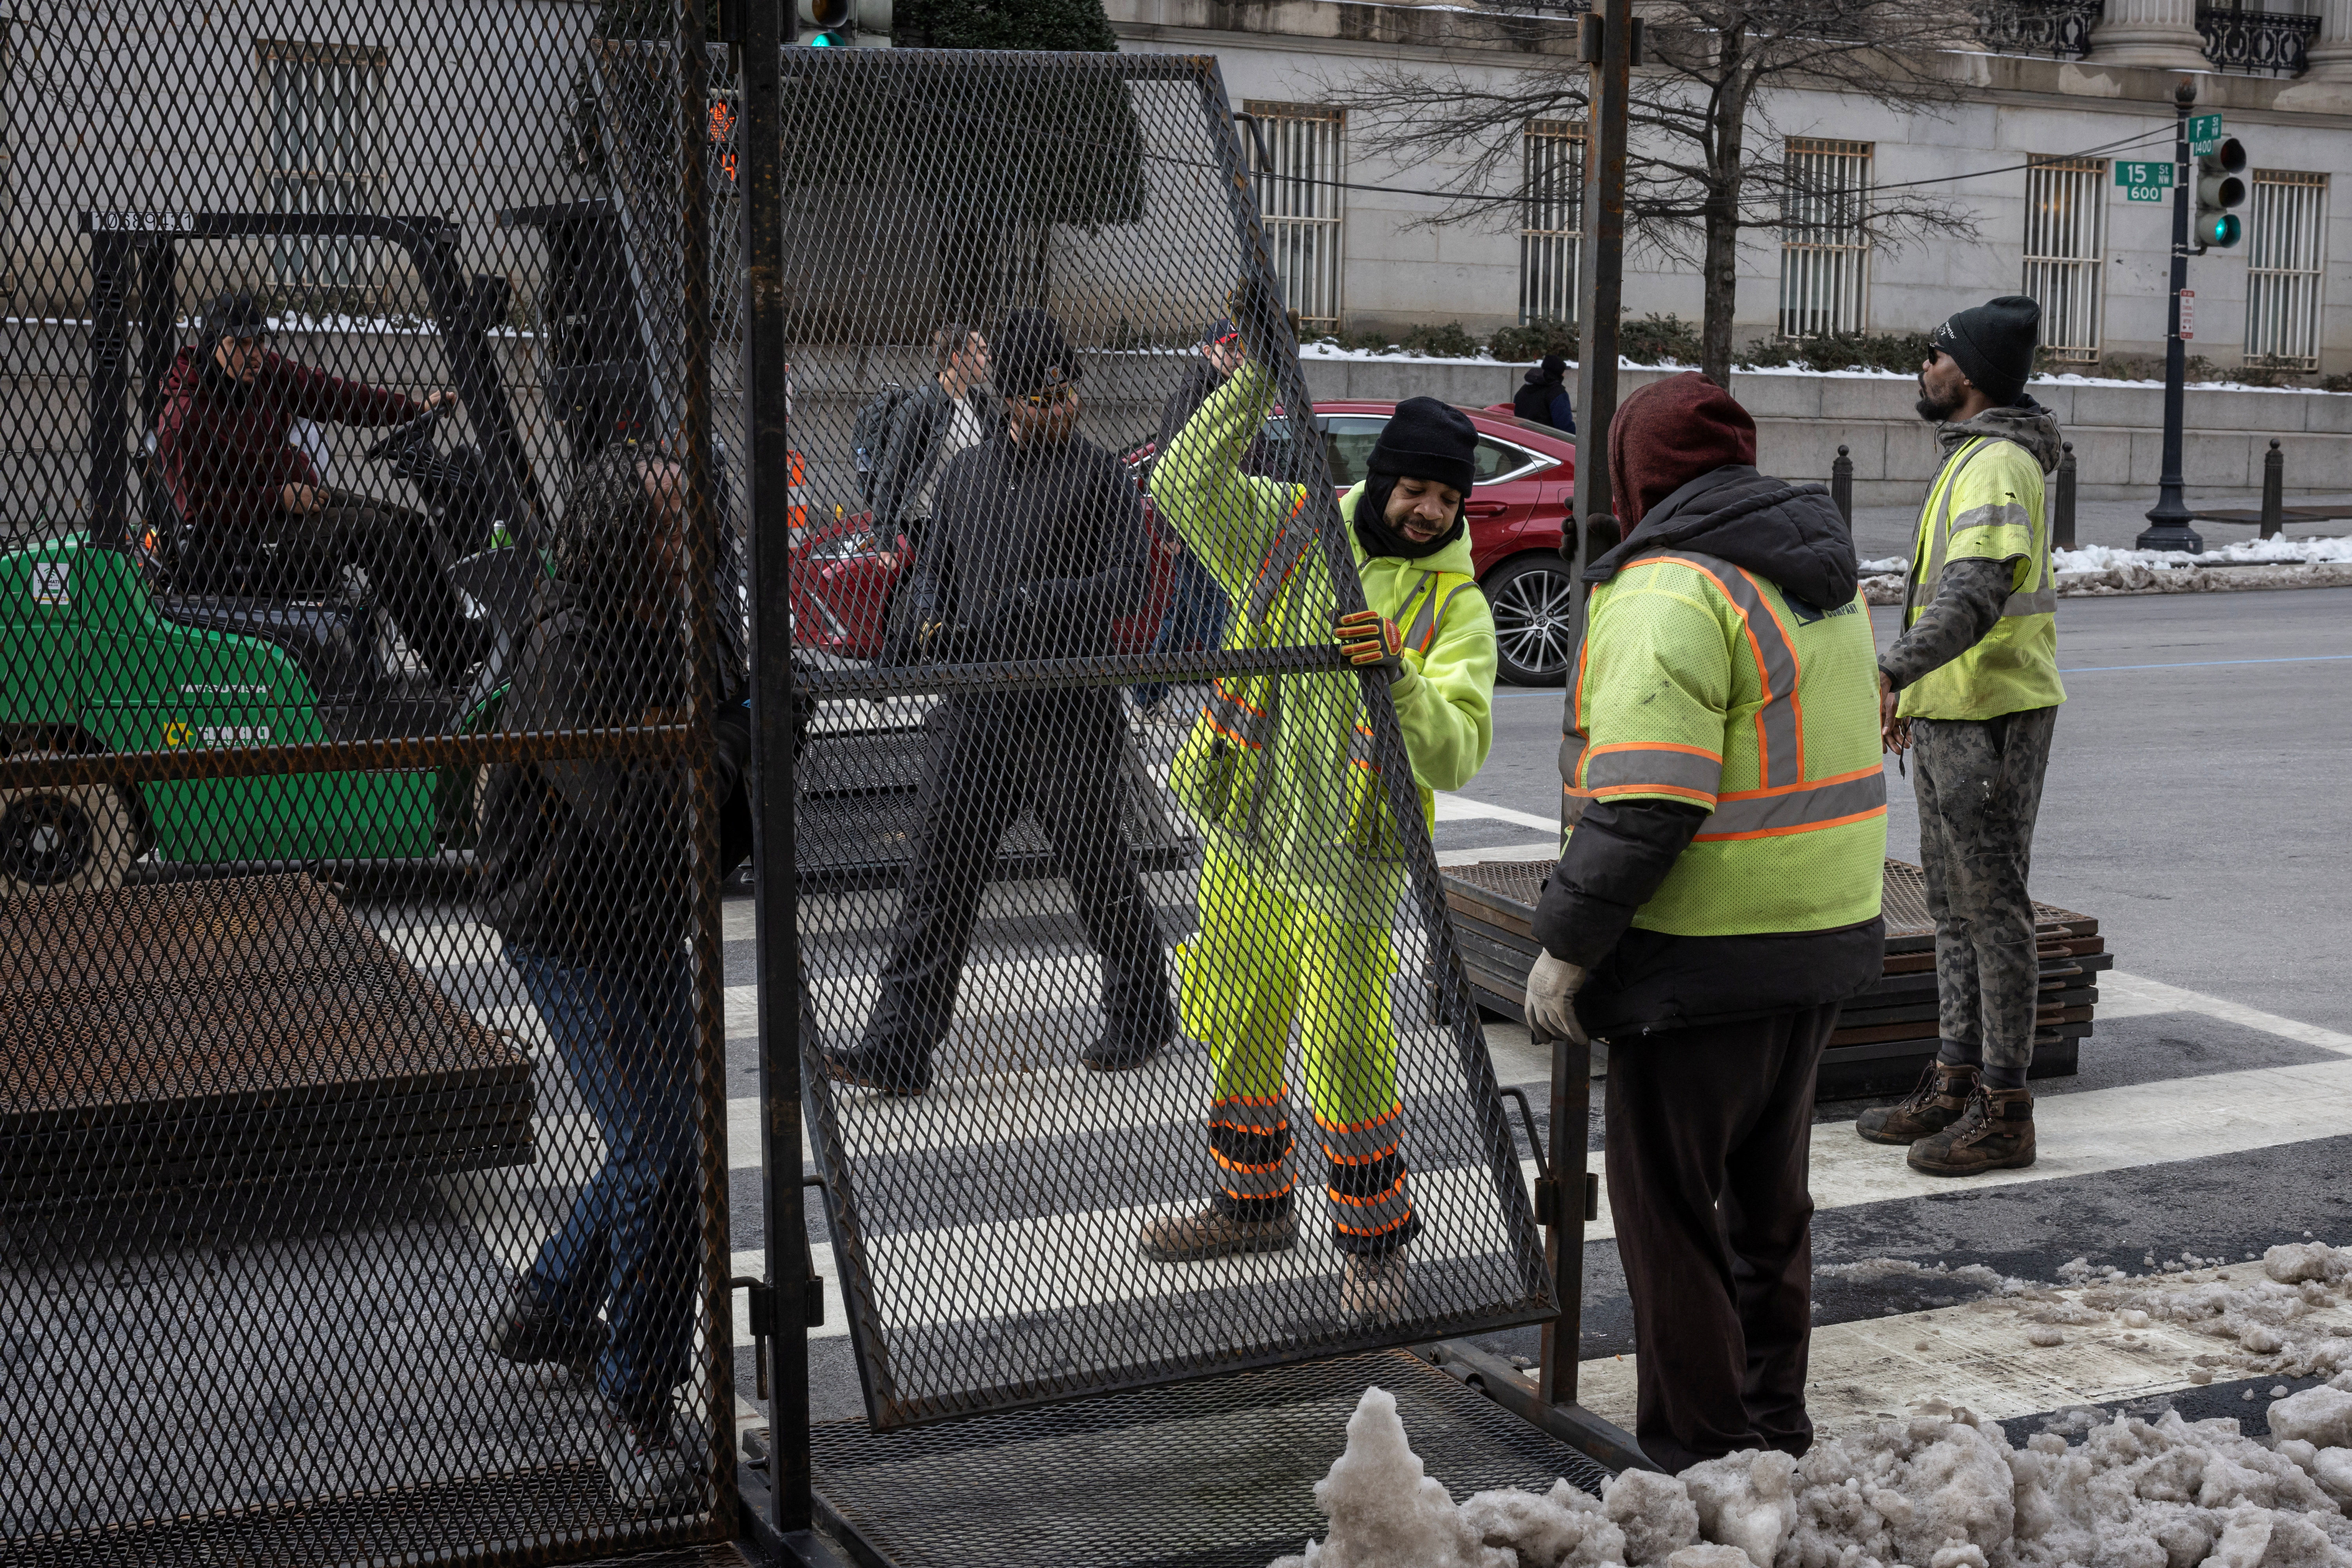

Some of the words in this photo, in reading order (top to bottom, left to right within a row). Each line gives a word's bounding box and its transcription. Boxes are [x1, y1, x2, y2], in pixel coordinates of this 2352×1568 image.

[2197, 120, 2204, 138] F
[2212, 117, 2219, 126] St
[2211, 127, 2219, 136] NW
[2196, 140, 2212, 153] 1400
[2127, 165, 2147, 183] 15
[2159, 165, 2169, 174] St
[2158, 175, 2169, 184] NW
[2131, 187, 2159, 200] 600
[1826, 603, 1859, 618] COMPANY
